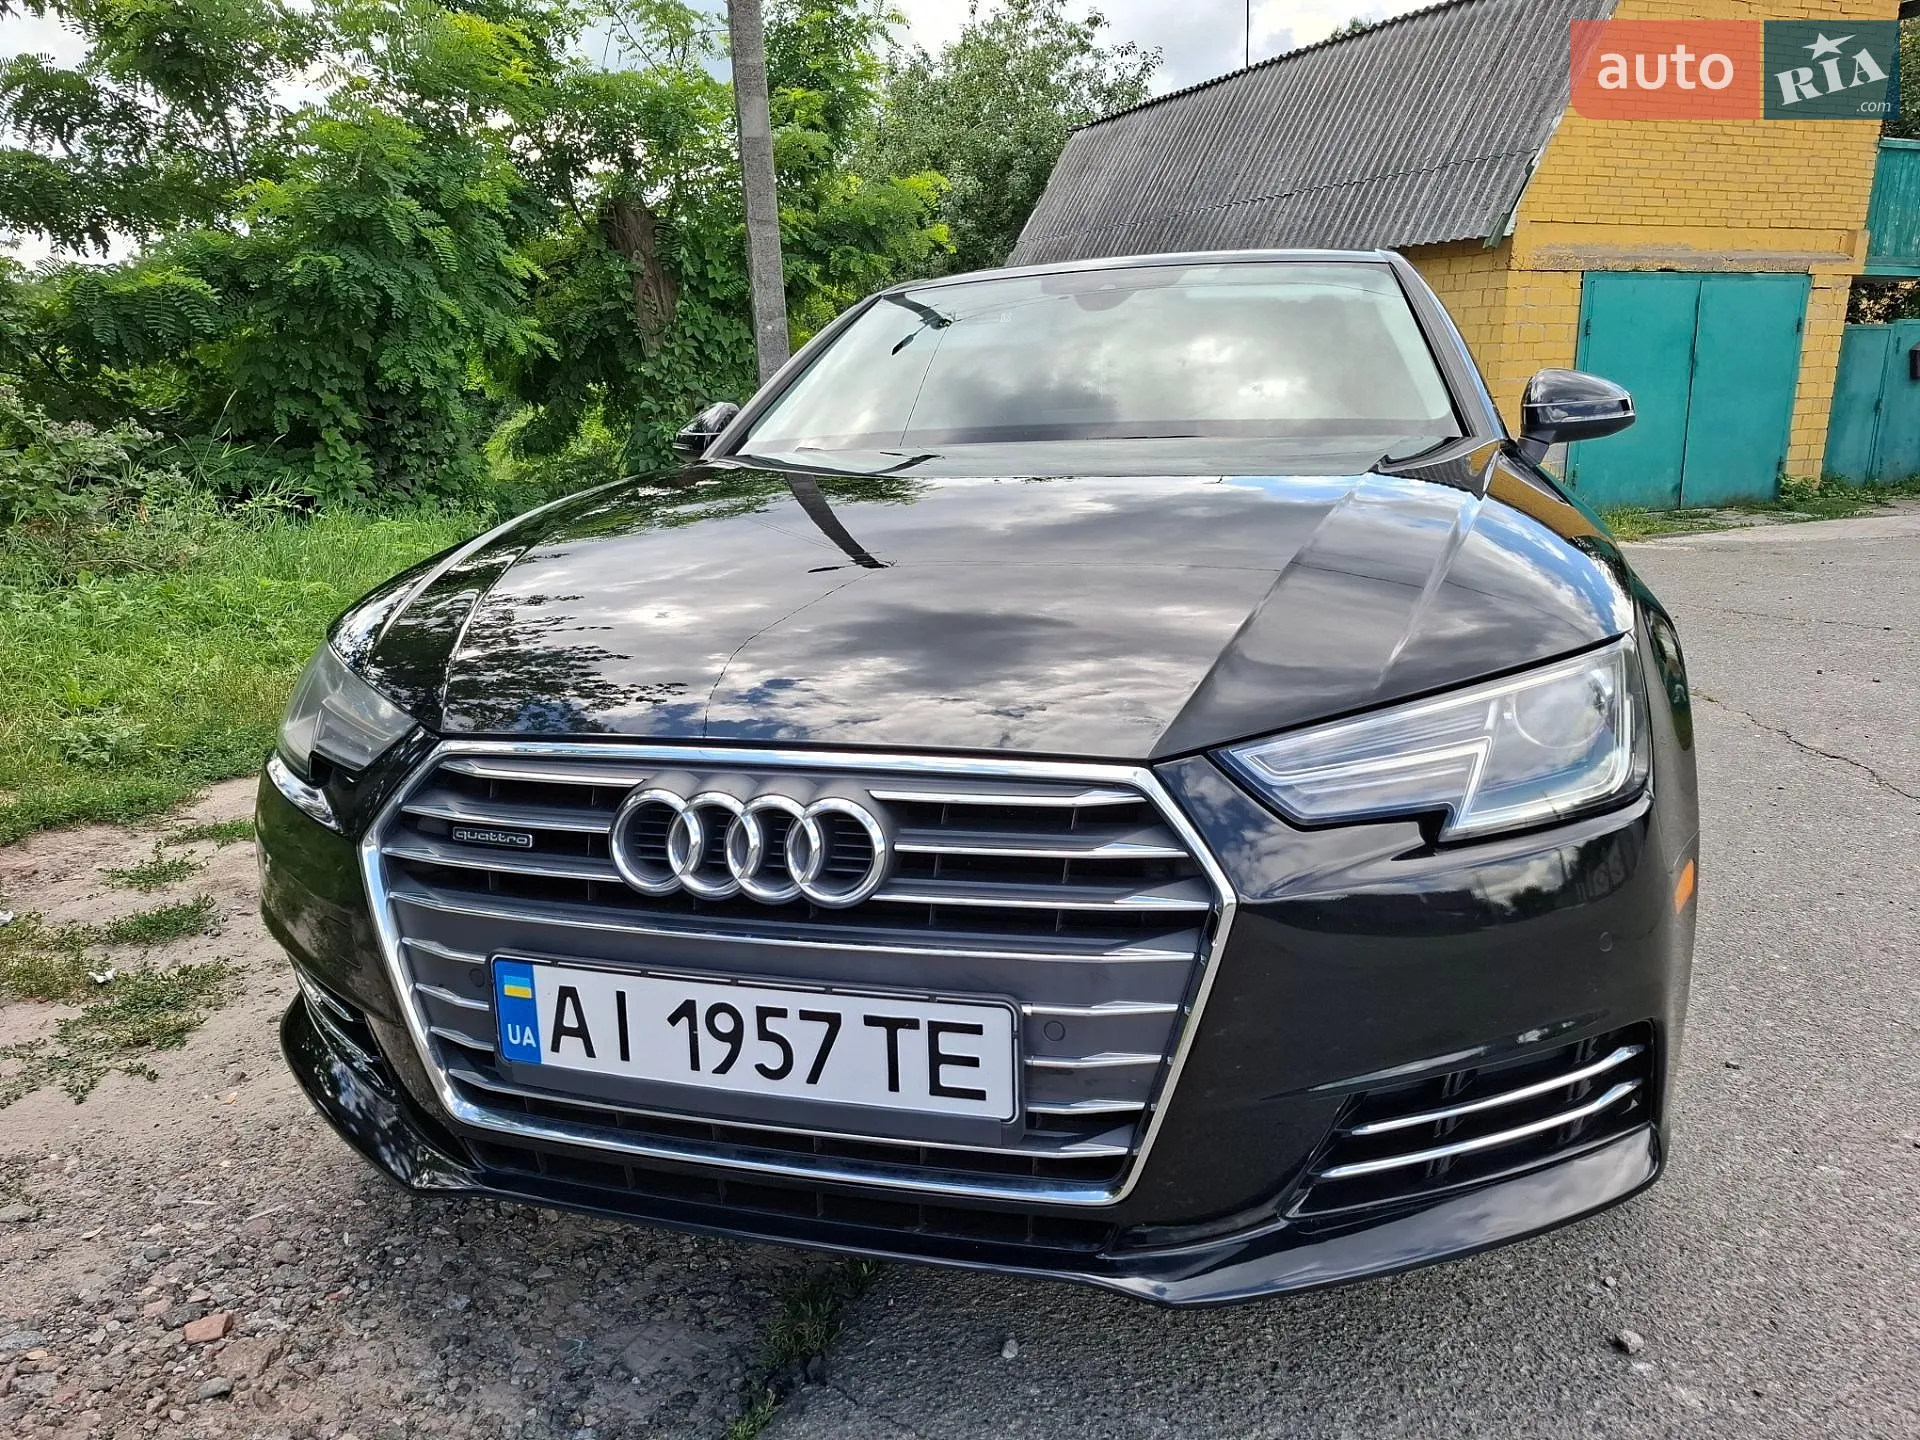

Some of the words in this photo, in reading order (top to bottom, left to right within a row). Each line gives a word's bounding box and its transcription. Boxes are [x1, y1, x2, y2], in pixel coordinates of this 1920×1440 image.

[455, 830, 528, 844] quattro
[507, 1023, 537, 1048] UA
[550, 985, 631, 1061] AI
[667, 999, 842, 1085] 1957
[863, 1014, 987, 1101] TE
